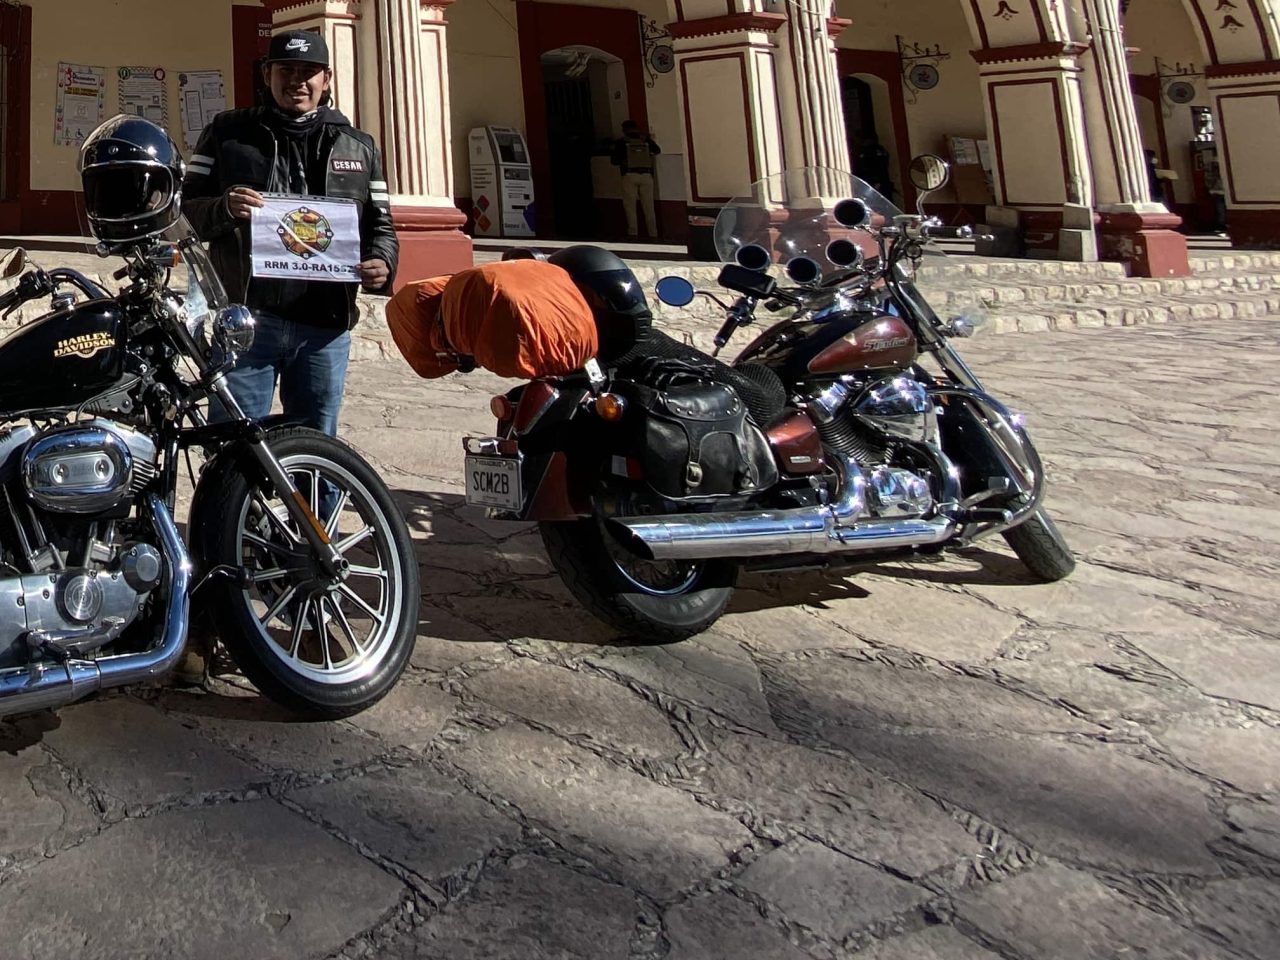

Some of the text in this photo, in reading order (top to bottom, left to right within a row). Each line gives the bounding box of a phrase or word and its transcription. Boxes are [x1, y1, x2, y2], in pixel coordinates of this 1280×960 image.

[333, 160, 363, 171] CESAR
[264, 260, 289, 270] RRM
[53, 338, 116, 358] DAVIDSON
[57, 332, 112, 348] HARLEY-
[472, 470, 510, 495] SCM2B
